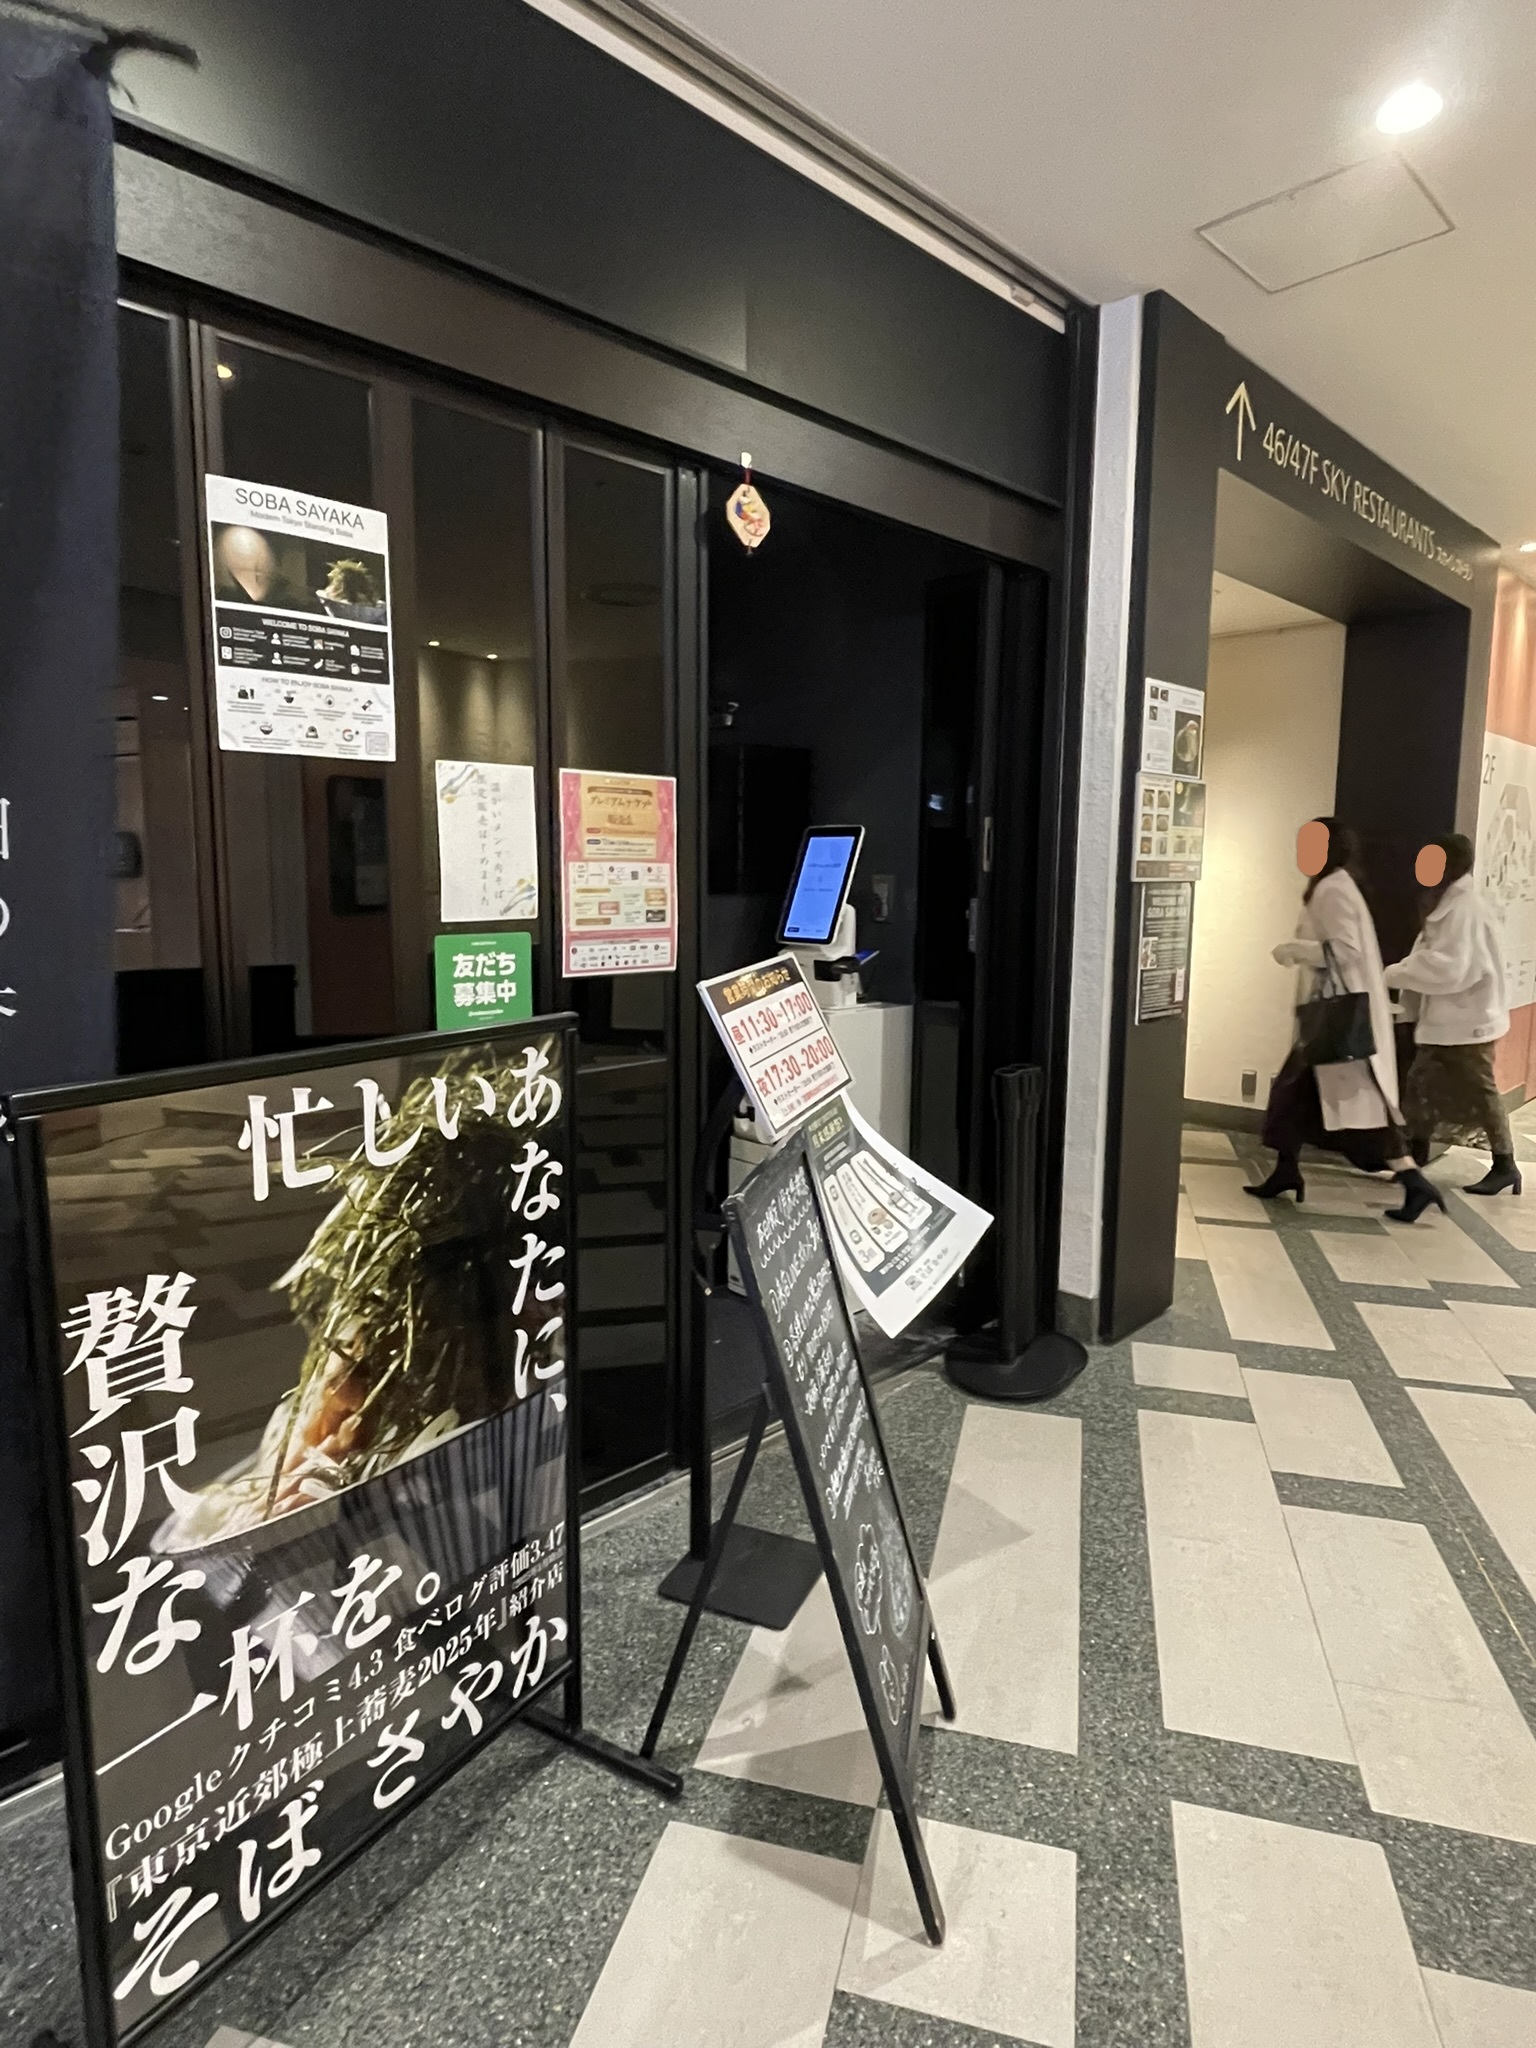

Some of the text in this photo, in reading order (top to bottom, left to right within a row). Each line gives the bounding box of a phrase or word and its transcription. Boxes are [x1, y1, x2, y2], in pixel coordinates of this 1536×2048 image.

[235, 487, 365, 530] SOBA SAYAKA
[1262, 421, 1437, 559] 46/47F SKY RESTAURANTS
[452, 951, 517, 978] 友だち
[453, 979, 517, 1008] 募集中
[237, 1075, 497, 1203] 忙しい
[507, 1046, 569, 1413] あなたに、
[60, 1269, 208, 1678] 贅沢な
[96, 1553, 442, 1776] 一杯を。
[112, 1615, 568, 2001] そば さやか
